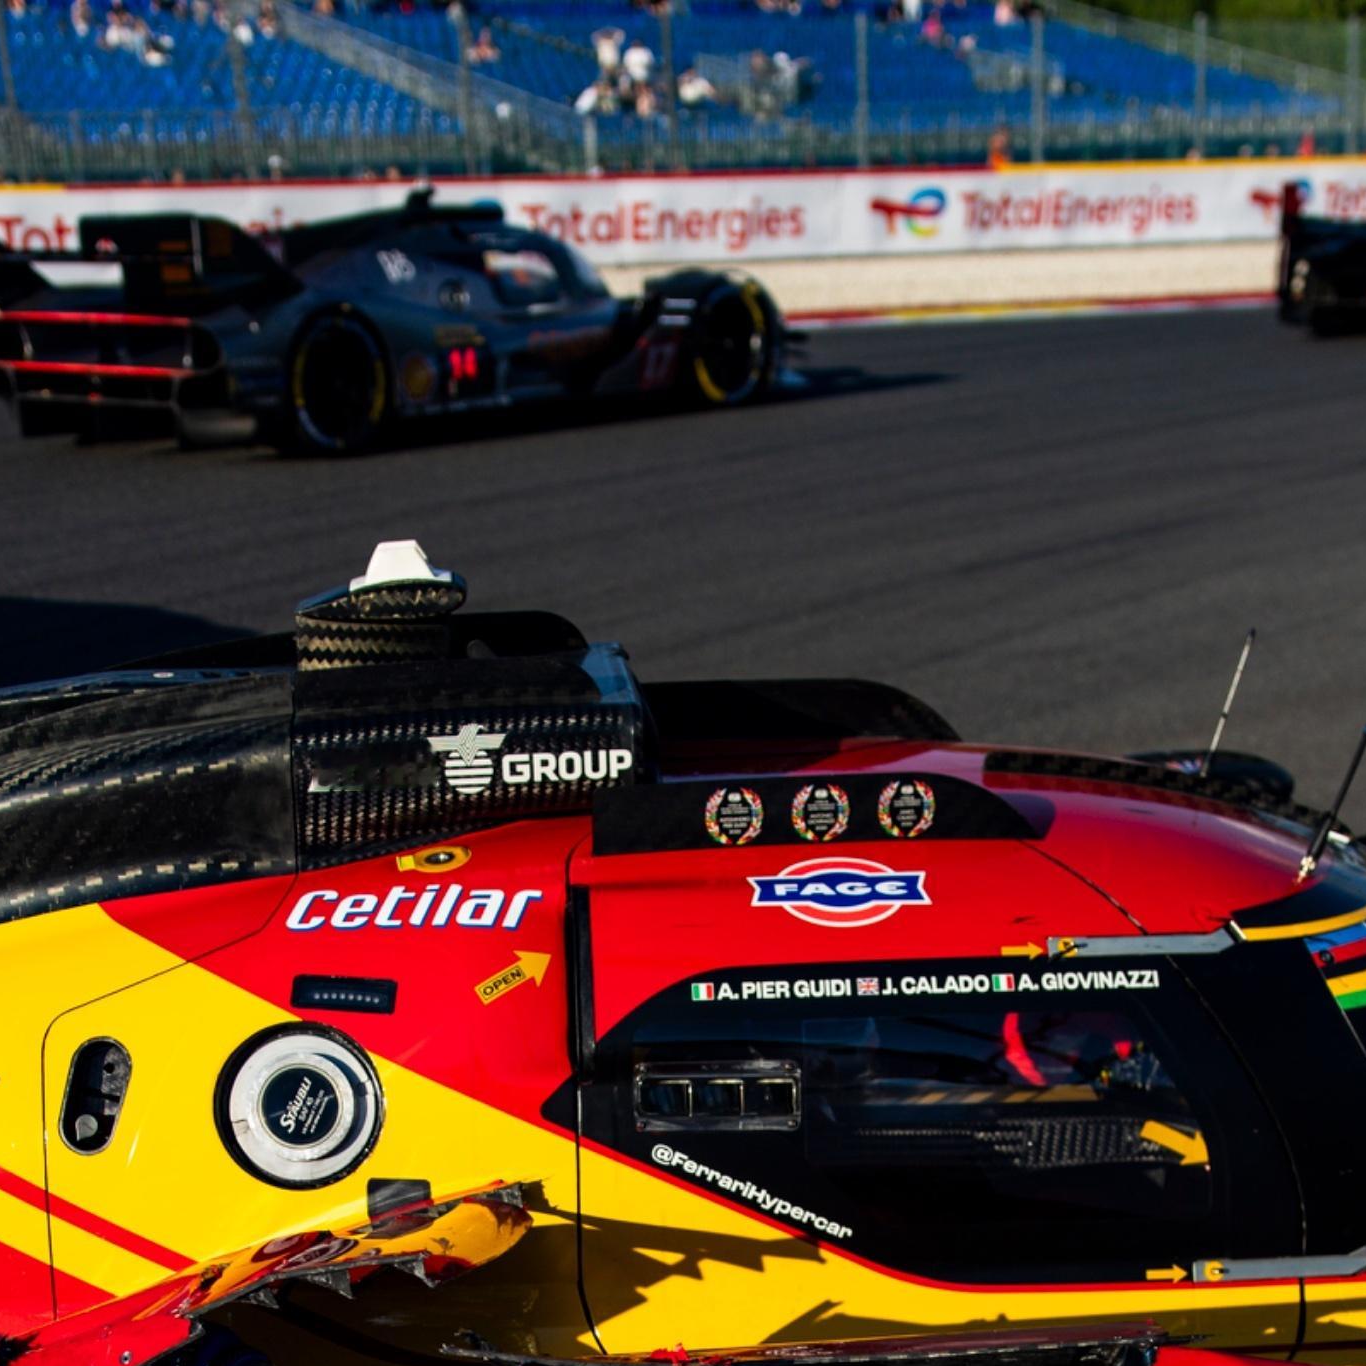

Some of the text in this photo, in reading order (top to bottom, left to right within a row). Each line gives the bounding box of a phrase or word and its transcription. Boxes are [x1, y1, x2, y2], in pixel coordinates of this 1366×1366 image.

[501, 749, 633, 784] GROUP
[773, 877, 908, 899] FAGE
[482, 967, 523, 998] OPEN
[717, 978, 852, 1000] A. PIER GUIDI
[882, 974, 990, 996] J. CALADO
[1018, 969, 1160, 992] A. GIOVINAZZI
[651, 1143, 853, 1240] @FerrariHypercar
